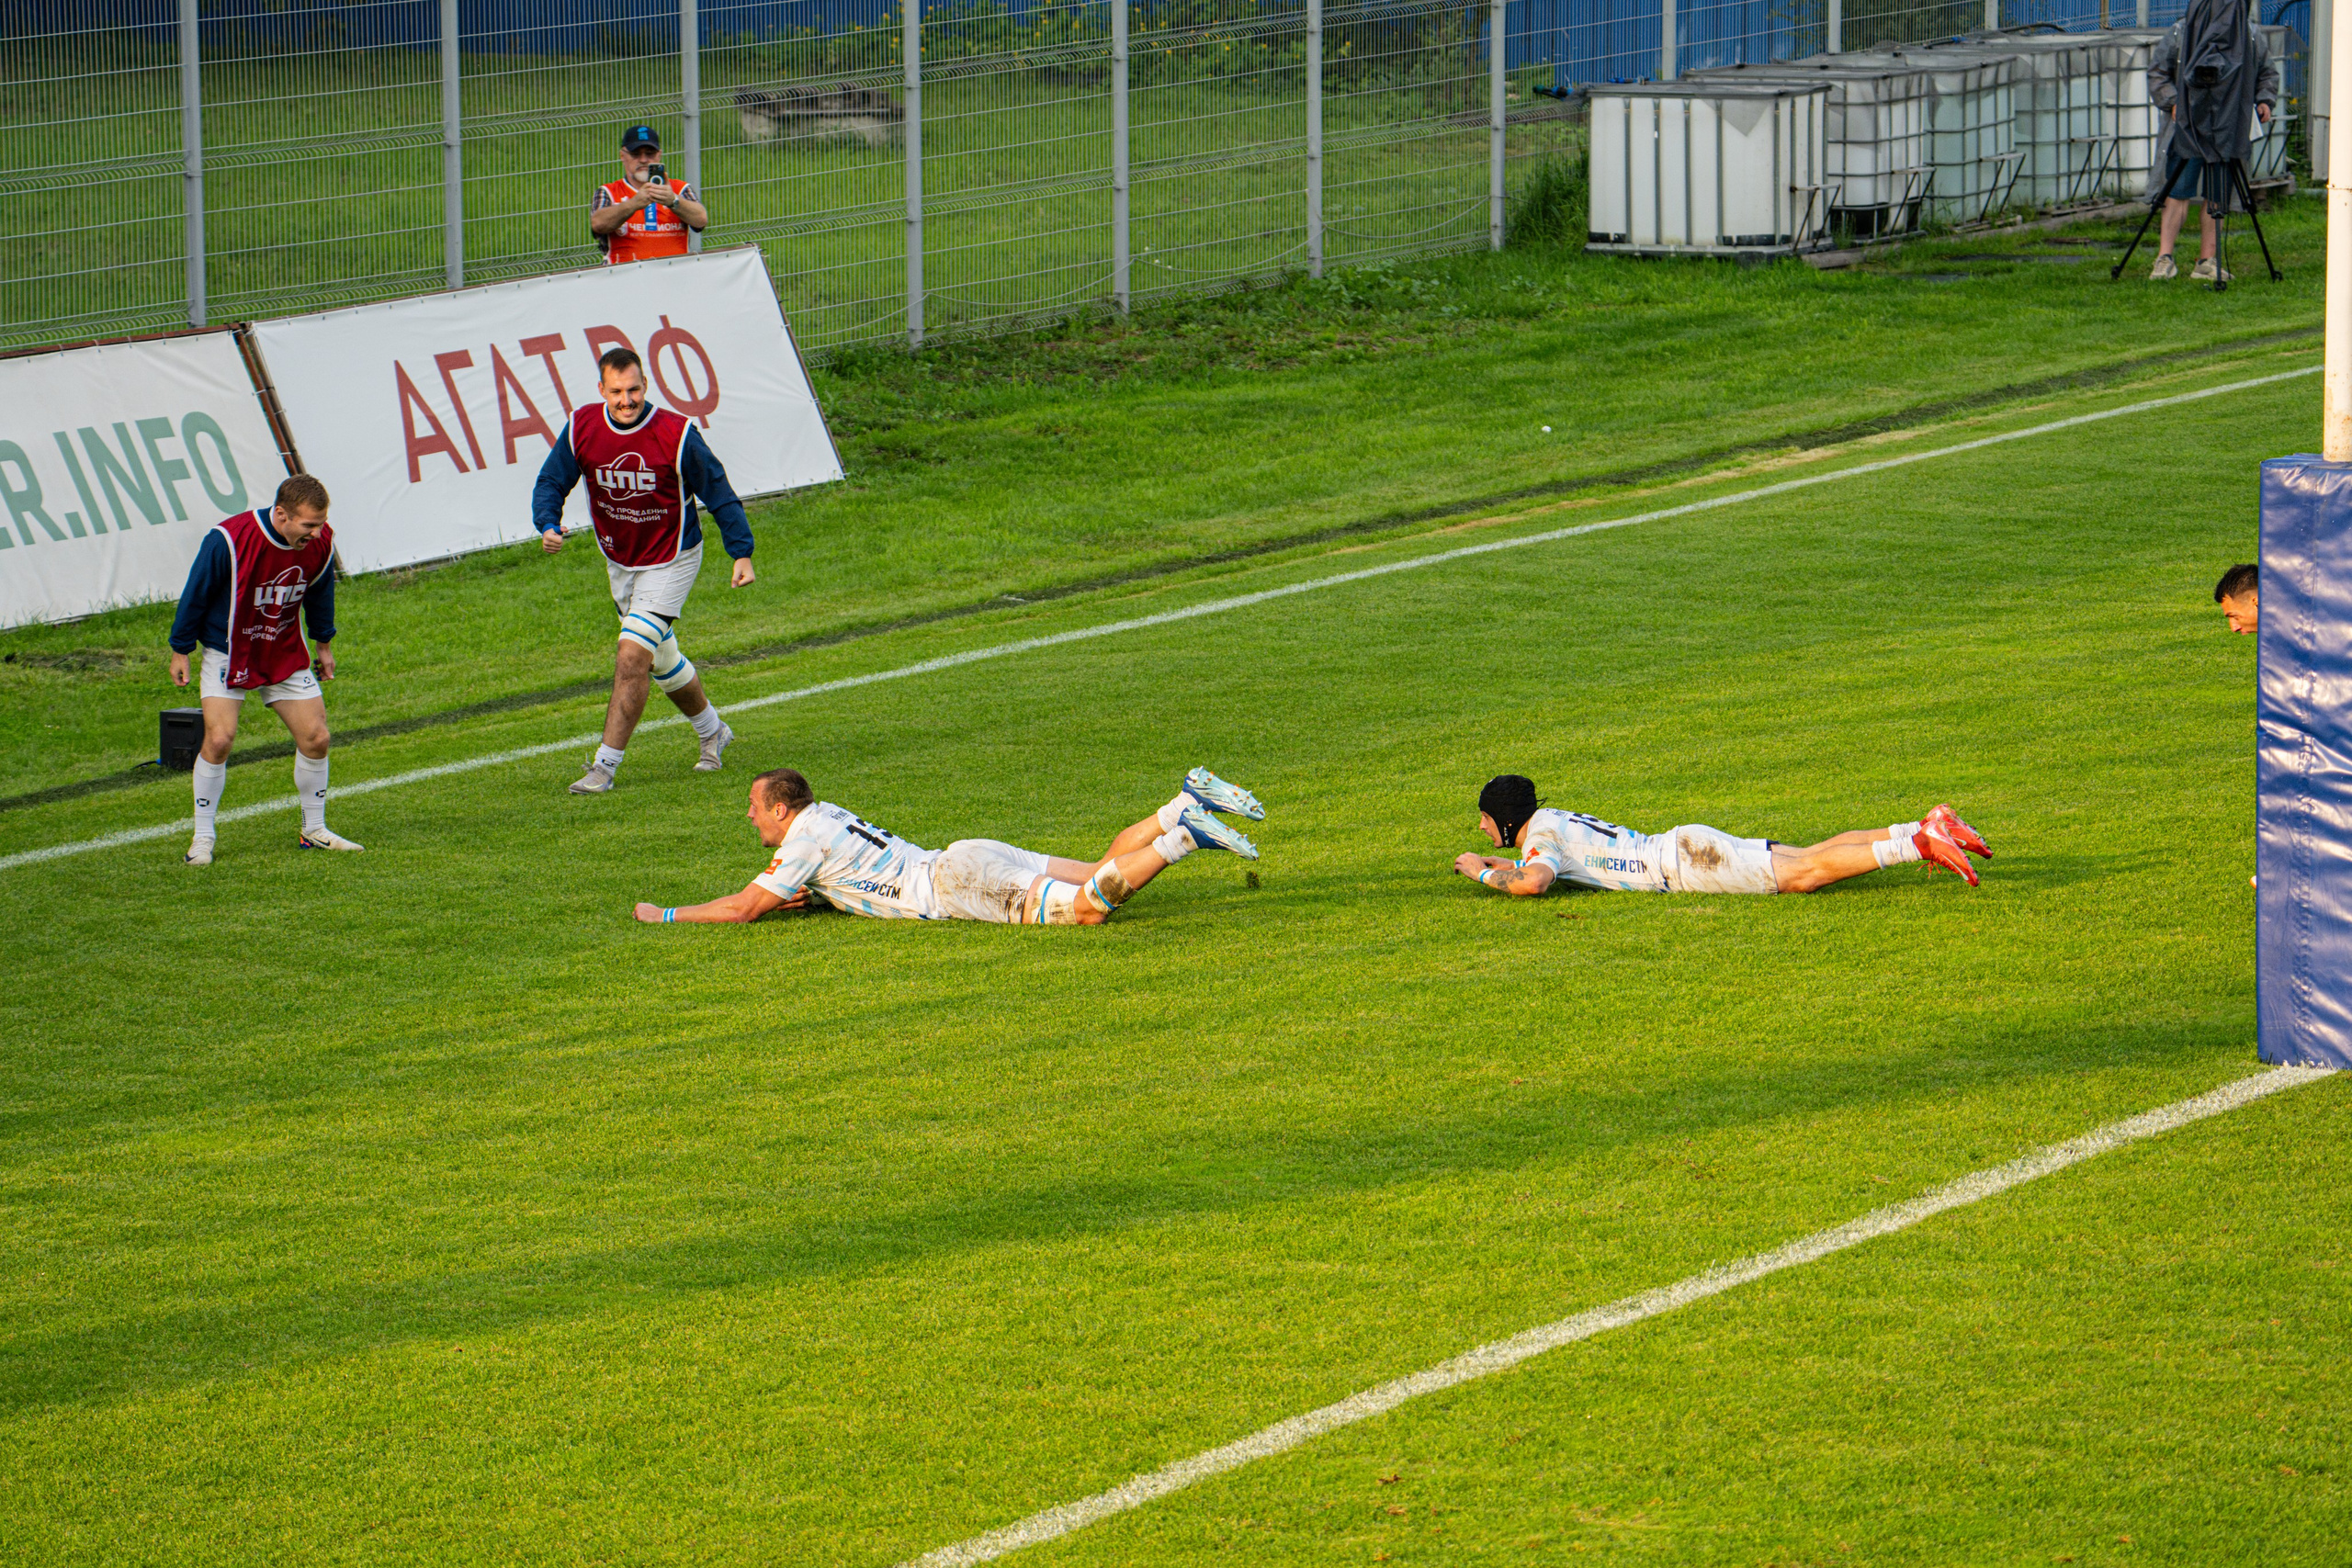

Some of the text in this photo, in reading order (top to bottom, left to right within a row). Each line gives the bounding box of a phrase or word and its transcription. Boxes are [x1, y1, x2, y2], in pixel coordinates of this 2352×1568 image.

[595, 468, 656, 491] ЦПС
[616, 507, 668, 516] ПРОВЕДЕНИЯ
[254, 583, 307, 606] ЦПС
[877, 884, 901, 900] СТМ
